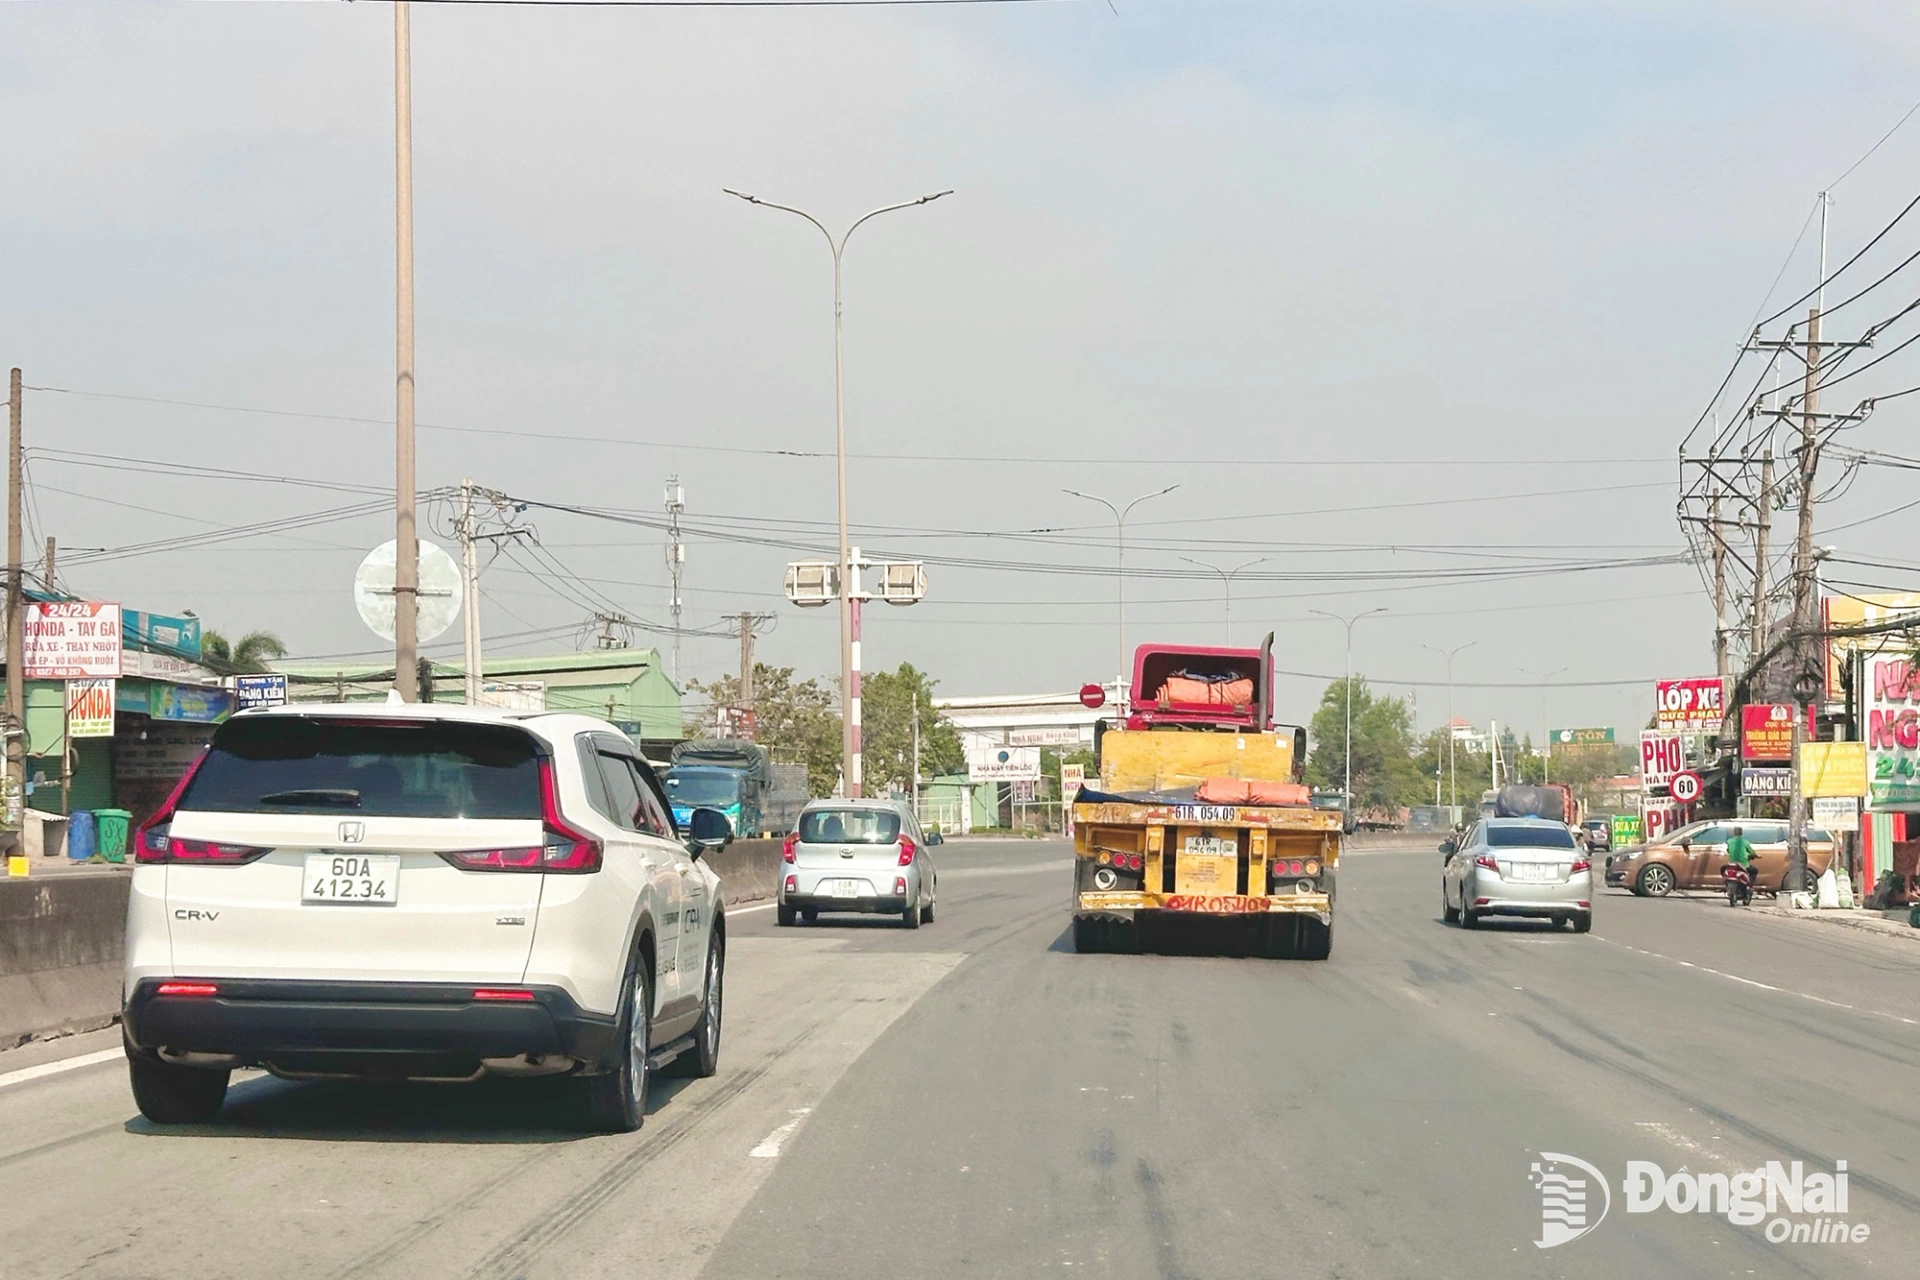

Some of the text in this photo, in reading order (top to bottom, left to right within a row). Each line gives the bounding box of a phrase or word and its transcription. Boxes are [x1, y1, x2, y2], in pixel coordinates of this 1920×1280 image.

[49, 604, 91, 617] 24/24
[24, 621, 65, 637] HONDA
[77, 621, 96, 637] TAY
[100, 621, 116, 637] GA
[47, 642, 59, 652] XE
[66, 642, 90, 652] THAY
[71, 688, 112, 720] HONDA
[1658, 681, 1720, 711] LỐP XE
[1064, 766, 1081, 778] NHÀ
[1678, 780, 1694, 793] 60
[1745, 773, 1774, 790] ĐĂNG
[331, 857, 370, 877] 60A
[313, 878, 386, 898] 412.34
[174, 909, 220, 922] CR-V
